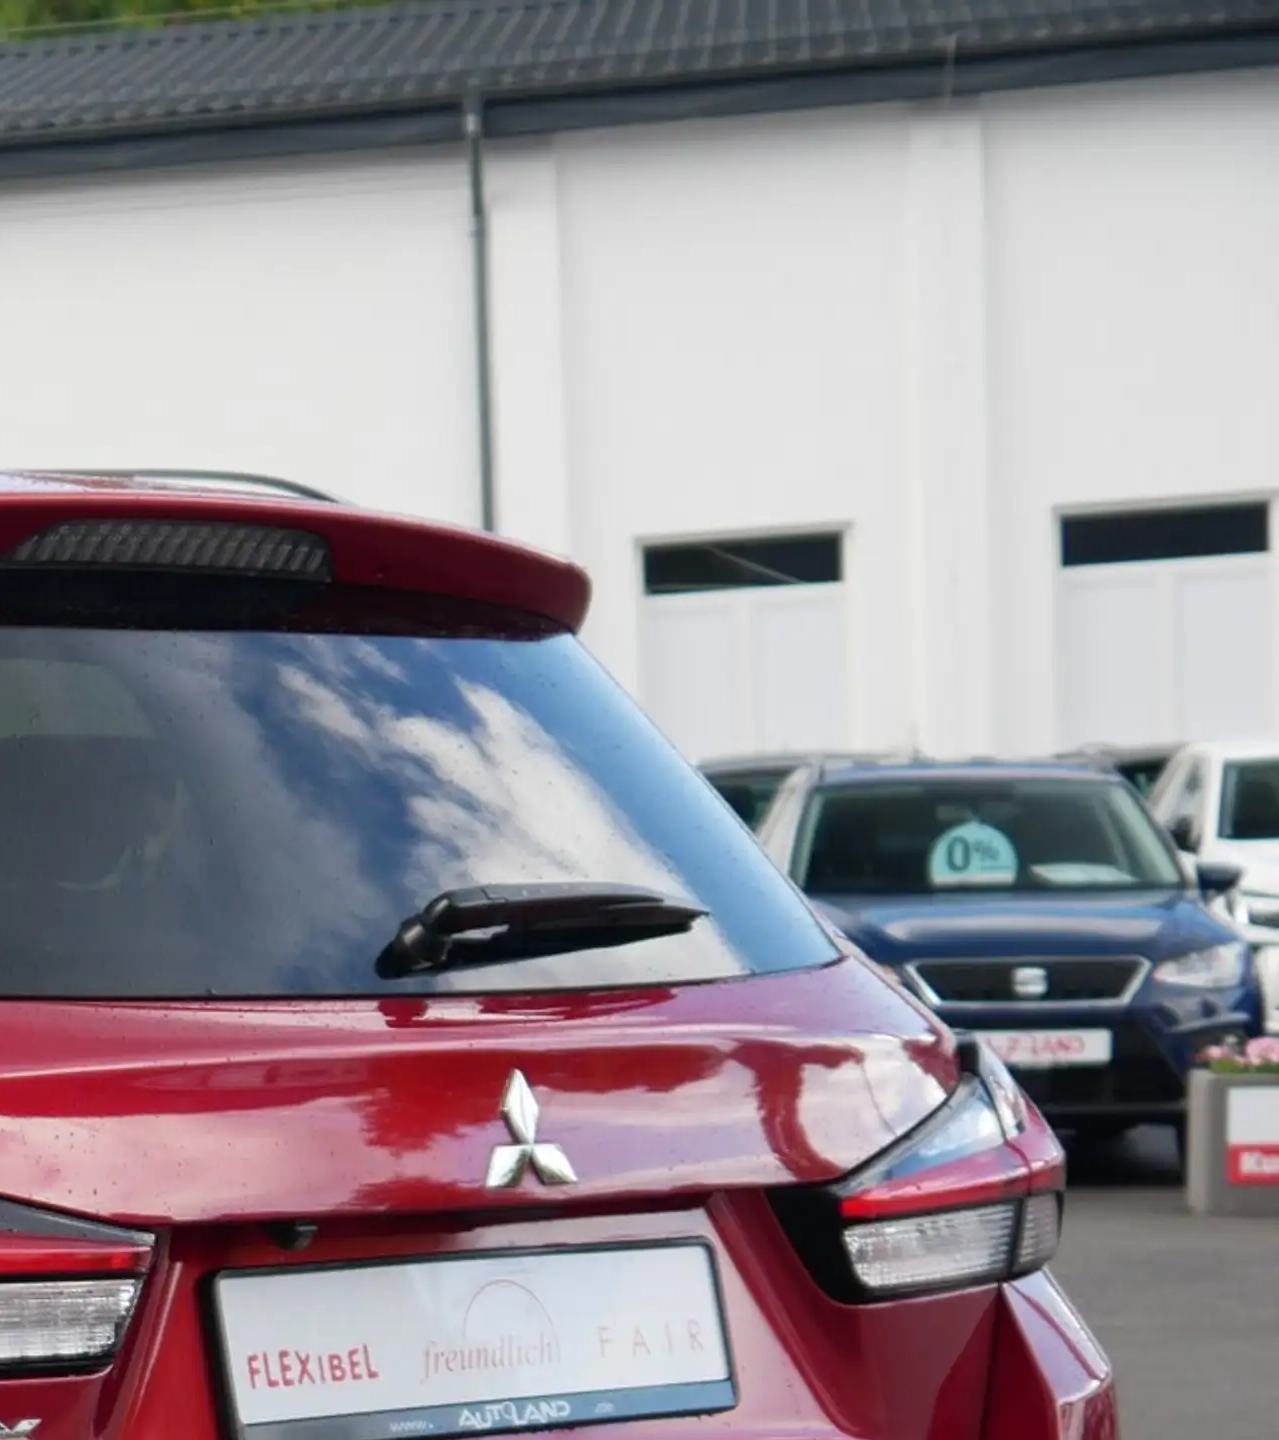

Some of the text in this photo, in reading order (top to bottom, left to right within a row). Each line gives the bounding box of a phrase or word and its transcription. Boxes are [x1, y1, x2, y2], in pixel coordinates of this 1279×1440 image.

[246, 1343, 379, 1390] FLEXIBEL
[419, 1331, 554, 1385] freundlich
[458, 1400, 571, 1430] AUTOLAND
